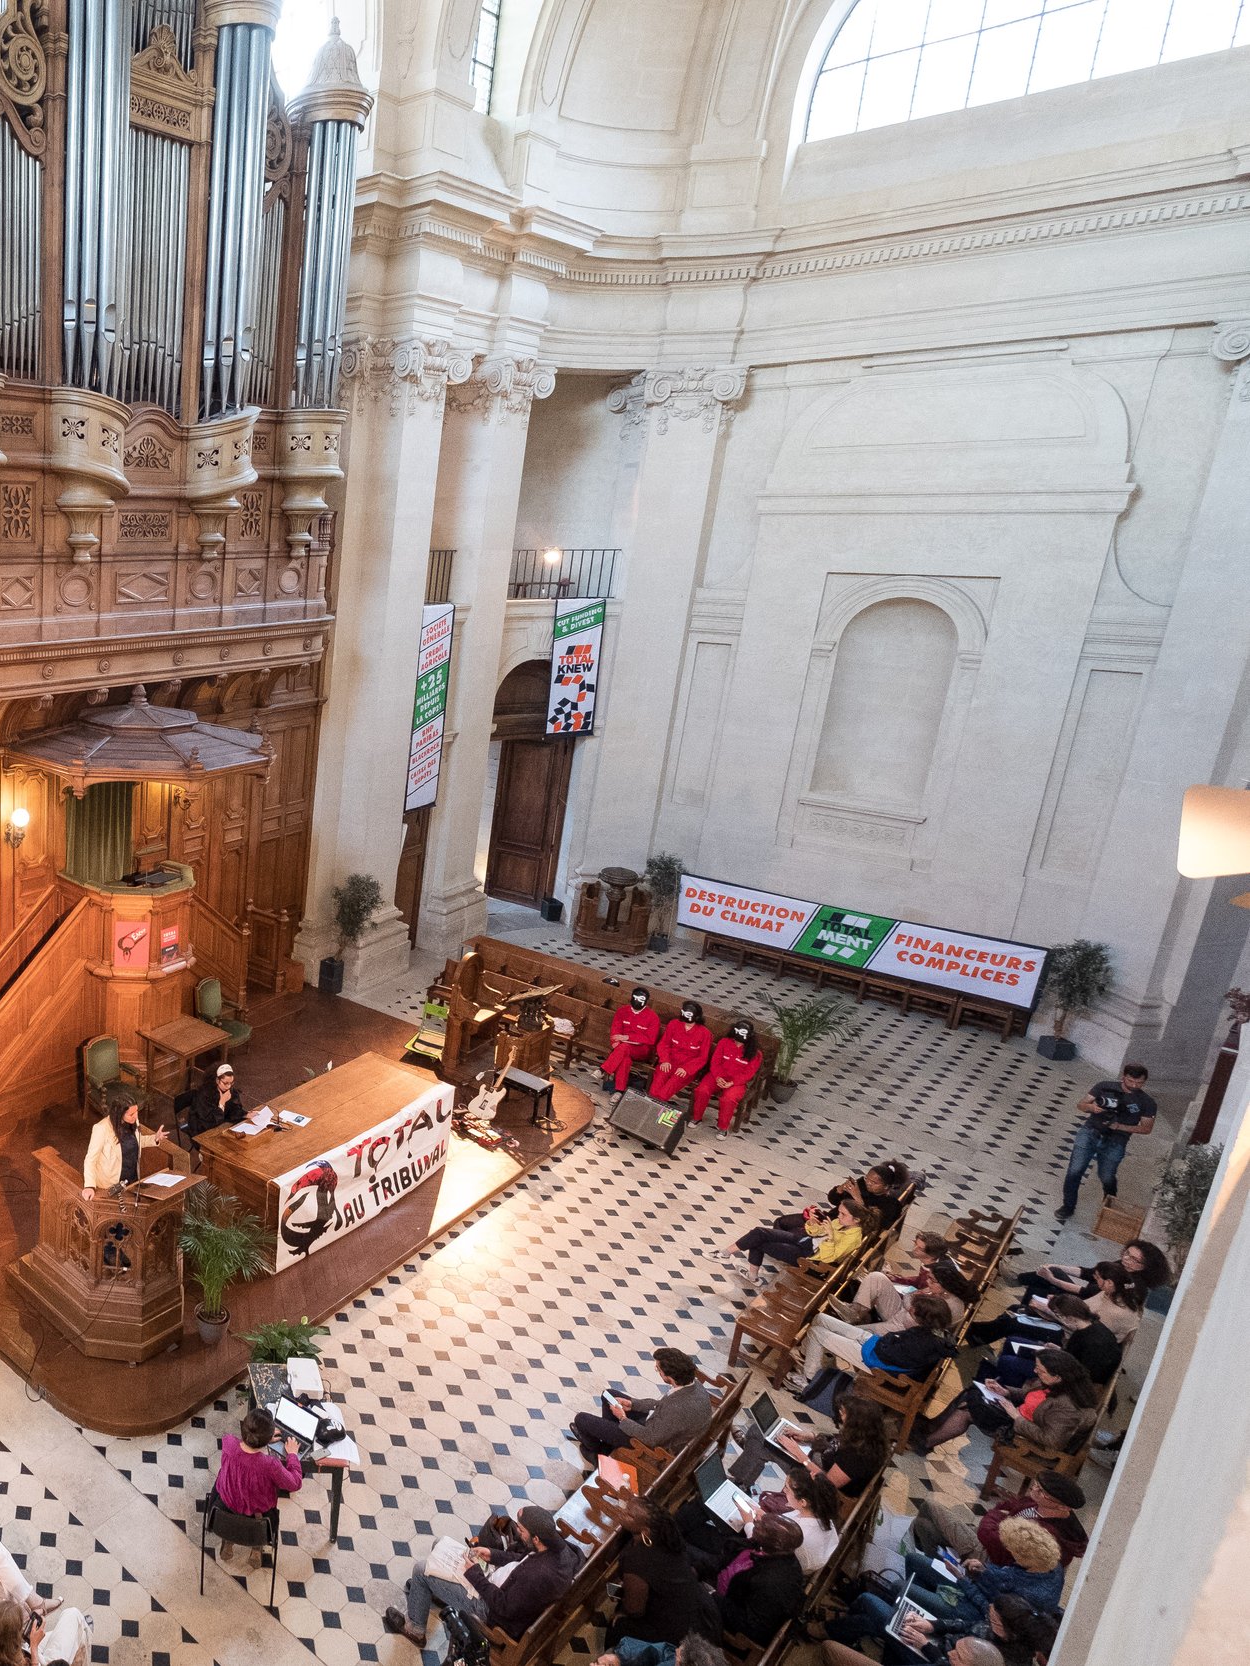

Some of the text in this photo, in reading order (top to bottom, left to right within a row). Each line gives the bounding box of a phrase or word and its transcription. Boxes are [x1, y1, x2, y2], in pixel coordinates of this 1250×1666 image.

[558, 607, 602, 627] CUT FUNDING
[571, 617, 594, 630] DIVEST
[421, 650, 448, 671] AGRICOLE
[558, 663, 594, 674] KNEW
[559, 654, 594, 664] TOTAL
[416, 682, 446, 707] MILLIARDS
[420, 695, 440, 712] DEPUIS
[416, 703, 442, 725] LA COP21
[415, 729, 439, 749] PARIBAS
[422, 724, 434, 737] BNP
[412, 742, 440, 765] BLACKROCK
[684, 887, 806, 923] DESTRUCTION
[688, 902, 785, 933] DU CLIMAT
[816, 929, 874, 951] MENT
[821, 919, 874, 940] TOTAL
[894, 934, 1036, 973] FINANCEURS
[896, 950, 1020, 987] COMPLICES
[347, 1099, 452, 1179] TOTAL
[343, 1139, 446, 1229] AU TRIBUNAL
